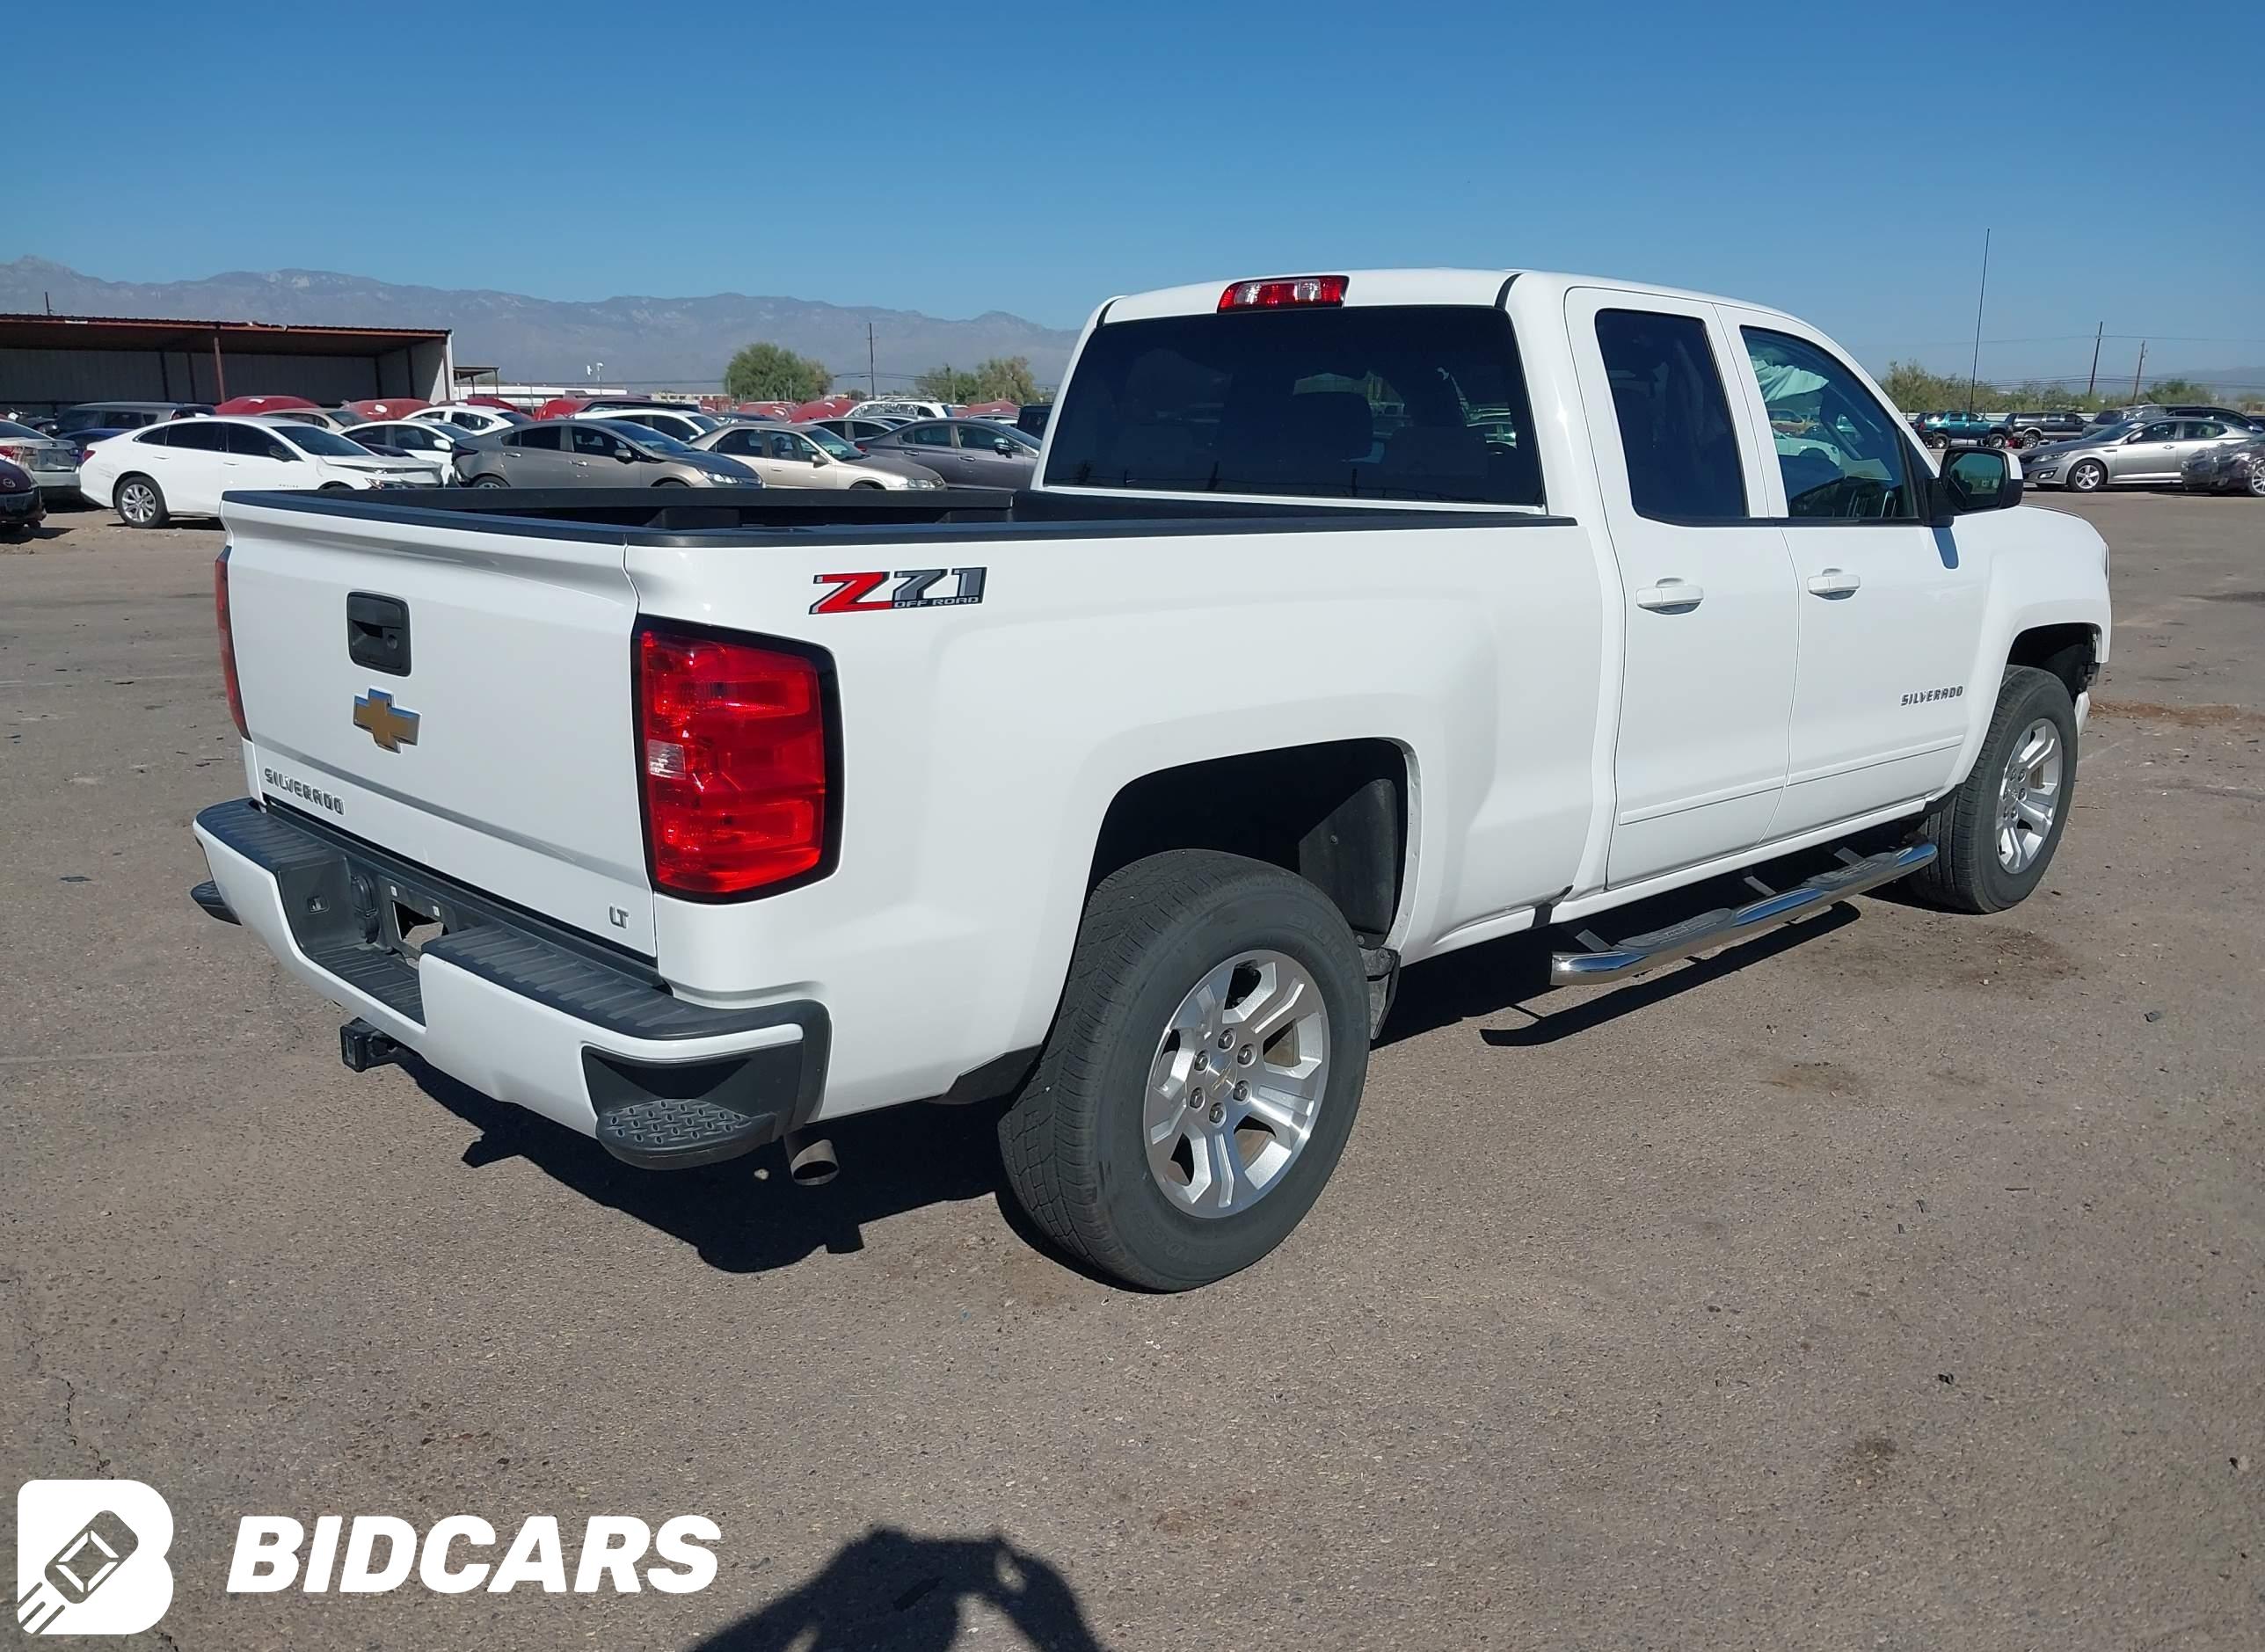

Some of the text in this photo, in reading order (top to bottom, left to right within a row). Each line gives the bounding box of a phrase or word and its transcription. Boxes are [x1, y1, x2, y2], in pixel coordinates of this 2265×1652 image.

[808, 566, 988, 615] Z71
[893, 595, 980, 609] OFF ROAD
[1900, 685, 1964, 707] SILVERADO
[264, 767, 346, 816] SILVERADO
[608, 905, 630, 929] LT
